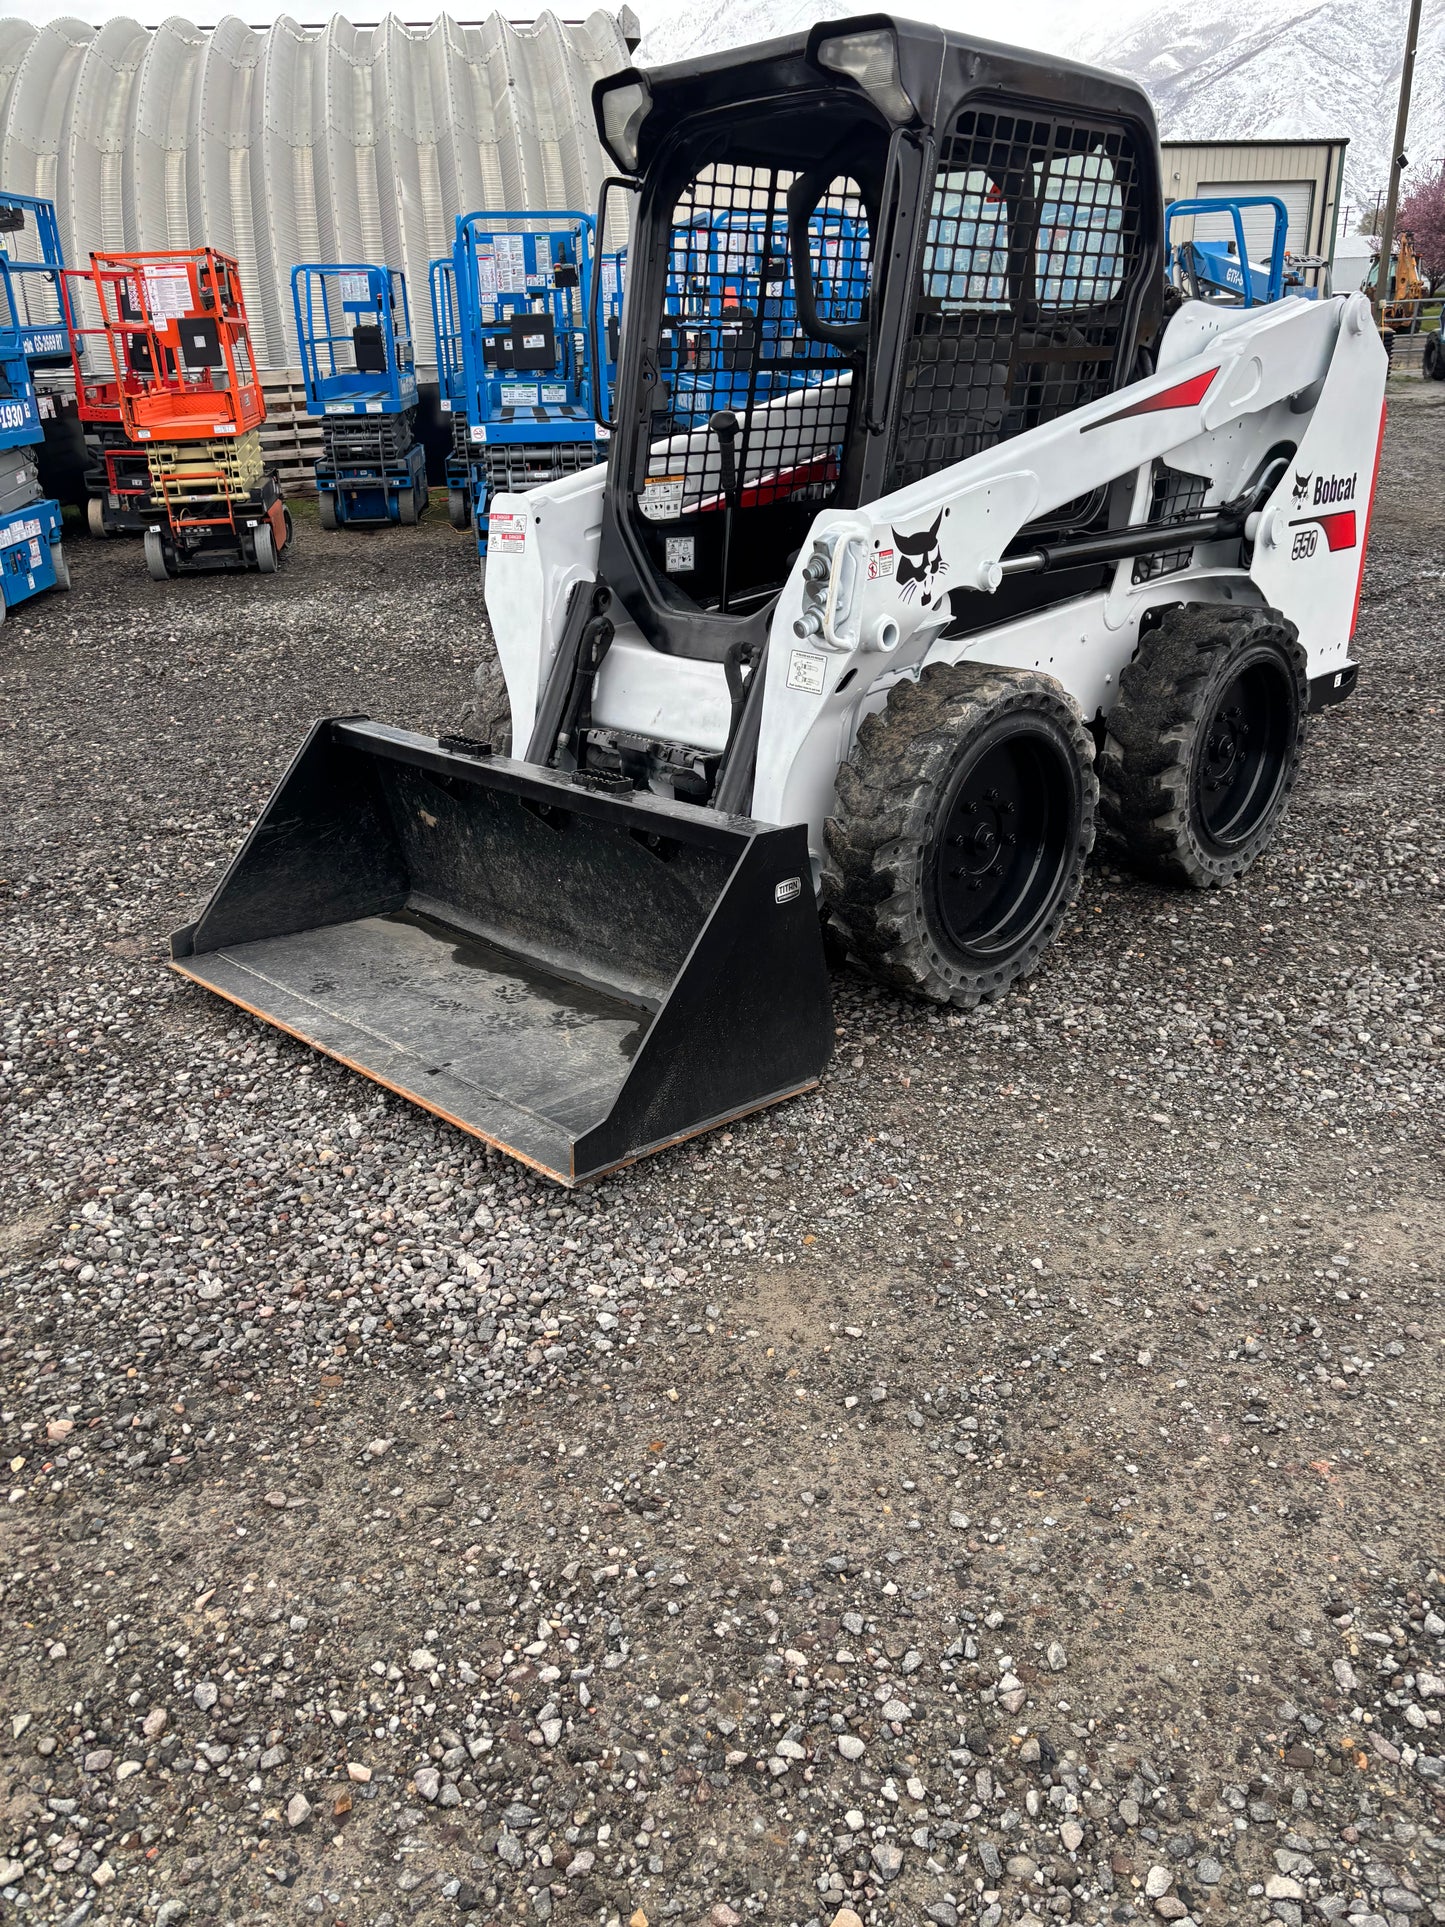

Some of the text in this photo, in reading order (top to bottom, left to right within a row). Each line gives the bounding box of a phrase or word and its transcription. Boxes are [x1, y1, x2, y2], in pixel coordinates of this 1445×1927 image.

[1313, 472, 1357, 505] Bobcat
[1291, 529, 1318, 561] 550
[779, 880, 798, 895] TITAN
